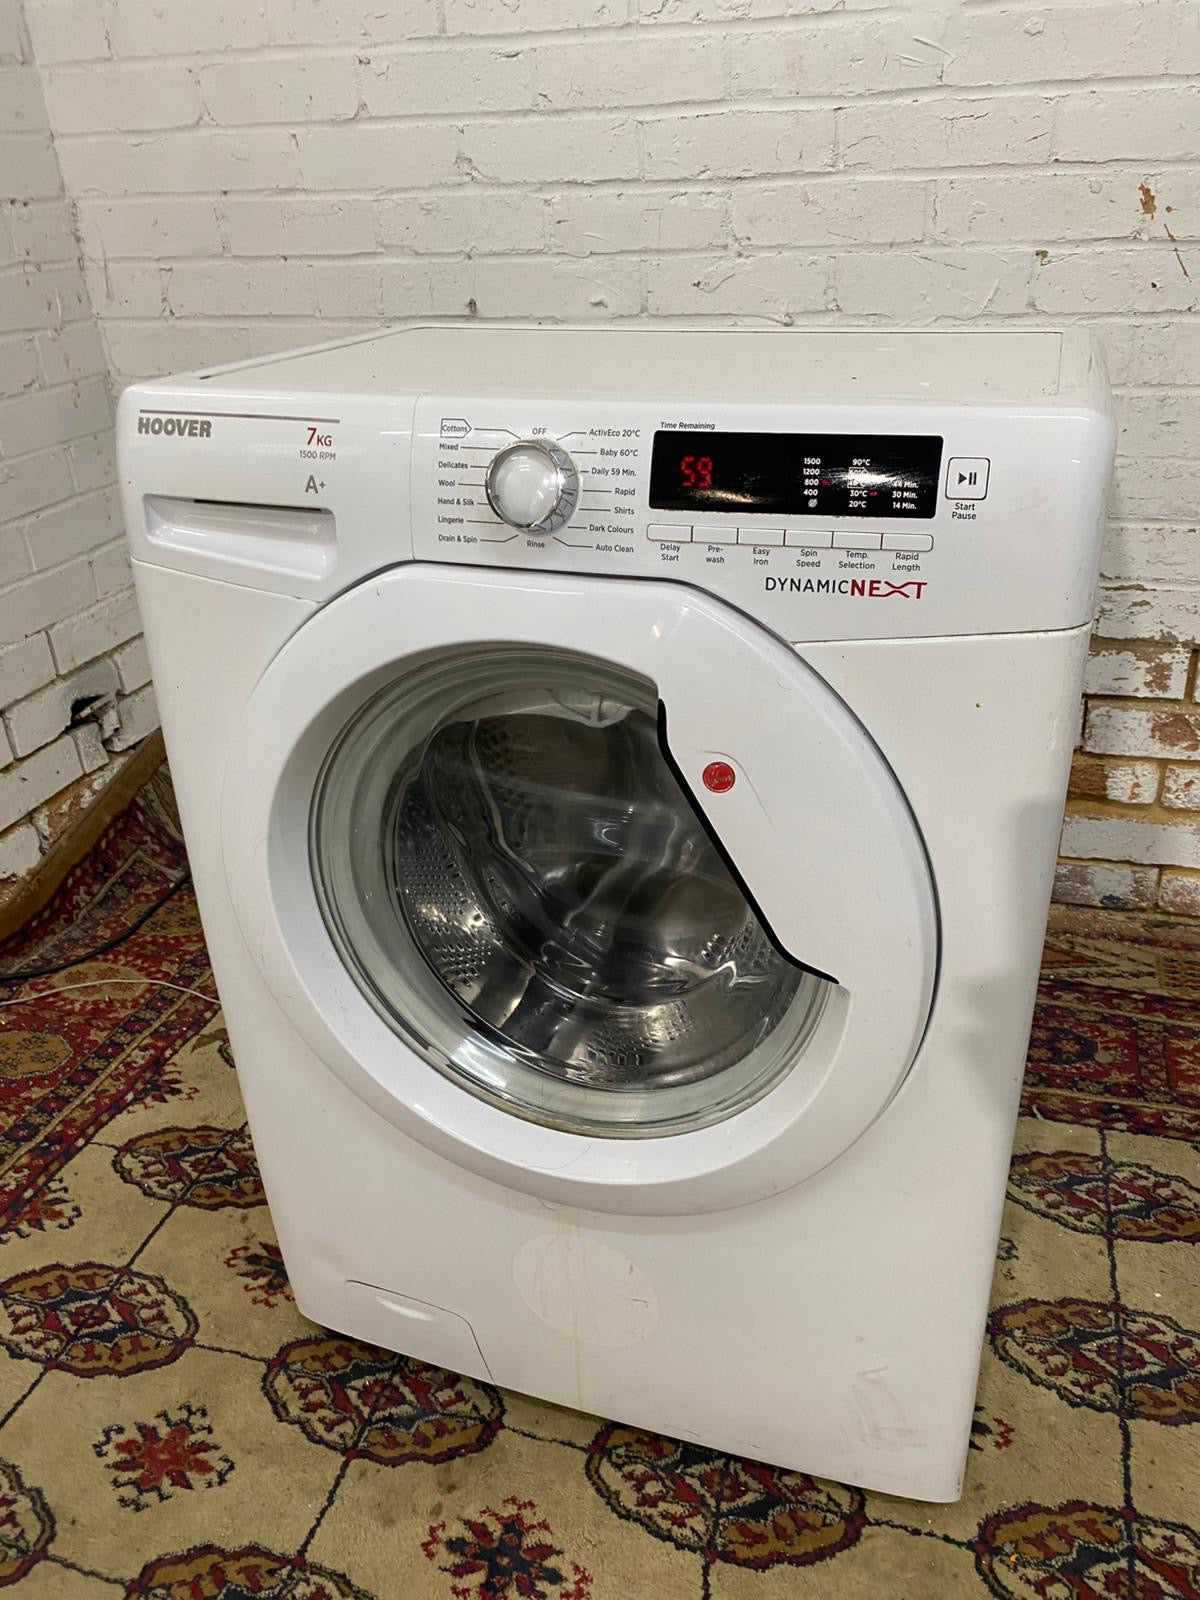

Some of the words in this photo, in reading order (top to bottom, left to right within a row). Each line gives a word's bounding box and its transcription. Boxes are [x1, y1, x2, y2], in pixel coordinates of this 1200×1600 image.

[137, 417, 212, 438] HOOVER
[678, 422, 715, 431] Remaining
[622, 429, 640, 437] 20°C
[299, 450, 318, 459] 1500
[319, 451, 336, 460] RPM
[600, 449, 618, 457] Baby
[620, 449, 638, 457] 60°C
[804, 457, 821, 465] 1500
[852, 458, 871, 466] 90°C
[592, 468, 609, 477] Daily
[611, 468, 620, 476] 59
[622, 469, 637, 477] Min.
[680, 455, 712, 488] 59
[305, 475, 326, 494] A+
[804, 478, 819, 486] 800
[615, 488, 635, 497] Rapid
[850, 489, 867, 497] 30°C
[849, 500, 867, 508] 20°C
[954, 502, 975, 511] Start
[614, 507, 634, 515] Shirts
[438, 516, 464, 525] Lingerie
[952, 512, 976, 520] Pause
[608, 525, 634, 534] Colours
[463, 536, 477, 545] Spin
[527, 540, 545, 548] Rinse
[596, 544, 613, 552] Auto
[614, 545, 634, 553] Clean
[660, 544, 680, 552] Delay
[708, 545, 723, 553] Pre-
[753, 548, 770, 557] Easy
[800, 549, 817, 557] Spin
[846, 550, 869, 560] Temp.
[896, 552, 919, 561] Rapid
[796, 559, 821, 568] Speed
[838, 561, 875, 570] Selection
[892, 562, 920, 572] Length
